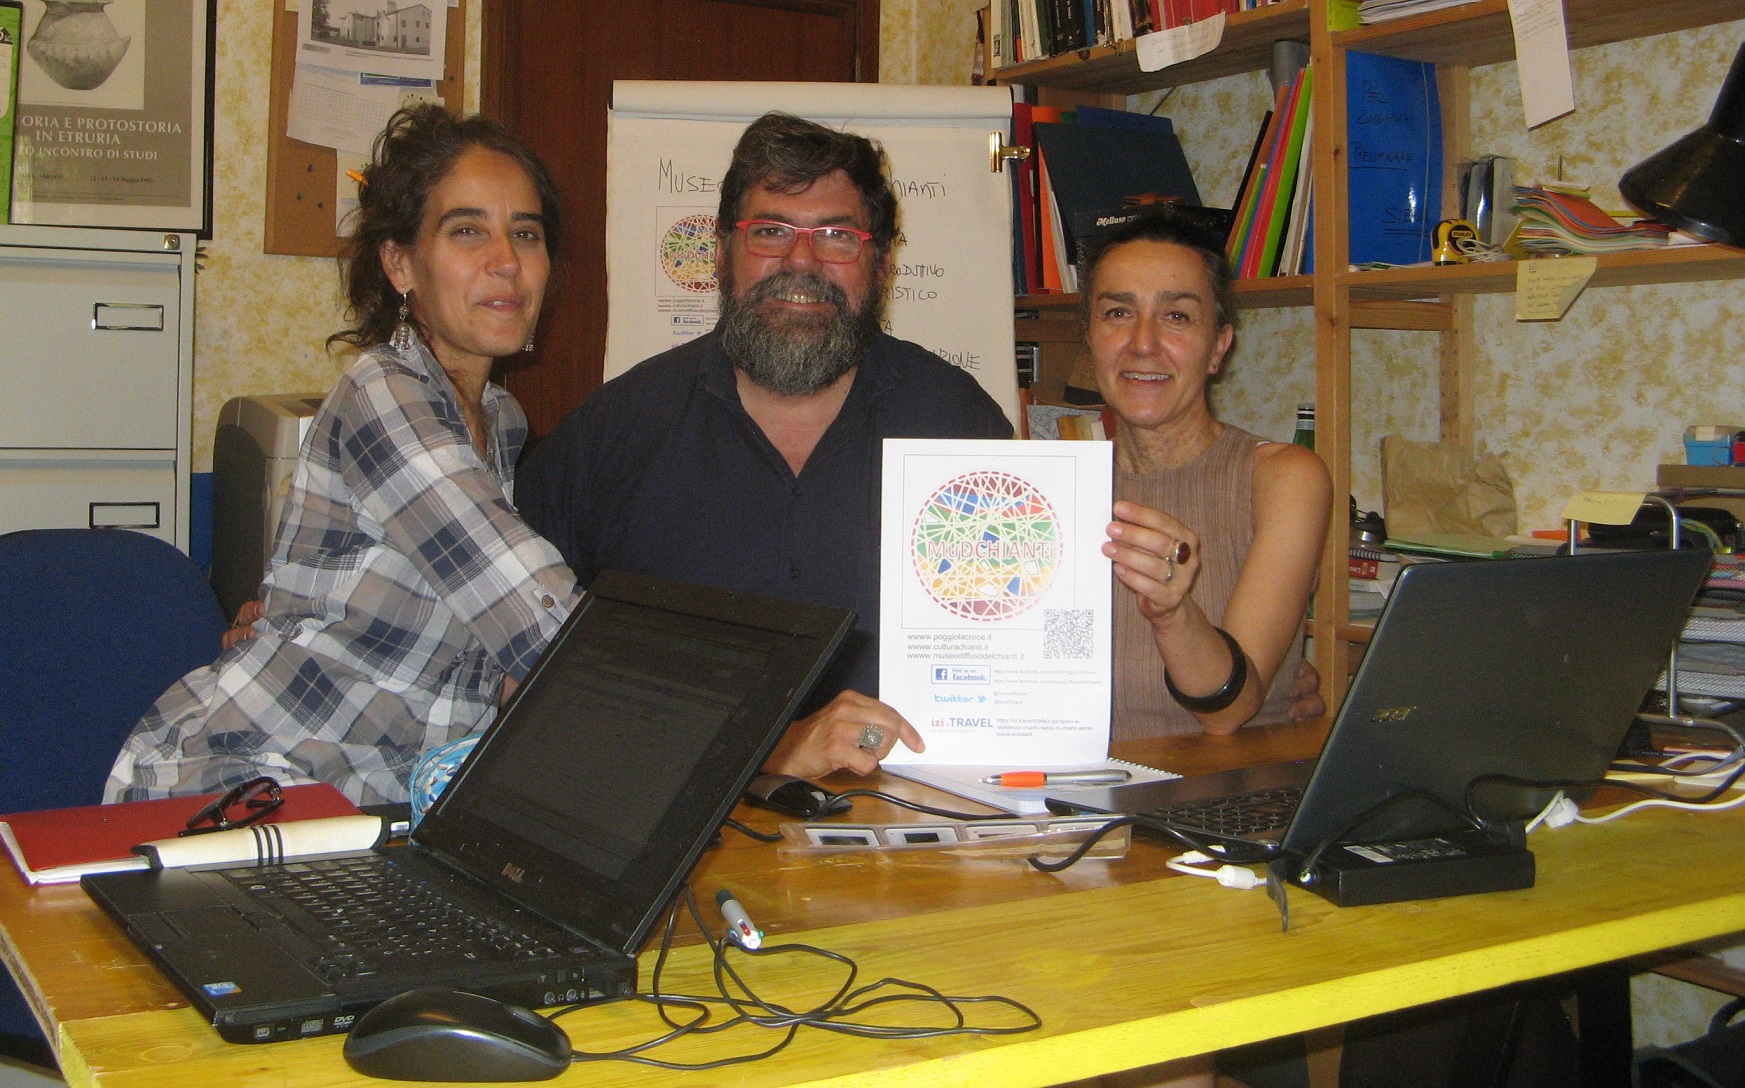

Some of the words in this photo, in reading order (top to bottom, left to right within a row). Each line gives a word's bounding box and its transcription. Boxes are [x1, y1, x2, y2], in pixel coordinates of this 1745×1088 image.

[65, 117, 73, 129] E
[77, 118, 182, 133] PROTOSTORIA
[36, 130, 53, 142] IN
[58, 131, 121, 145] ETRURIA
[39, 146, 103, 159] INCONTRO
[107, 150, 119, 159] DI
[123, 150, 158, 160] STUDI
[928, 541, 1055, 558] MuDCHIANTI
[934, 694, 973, 703] twitter
